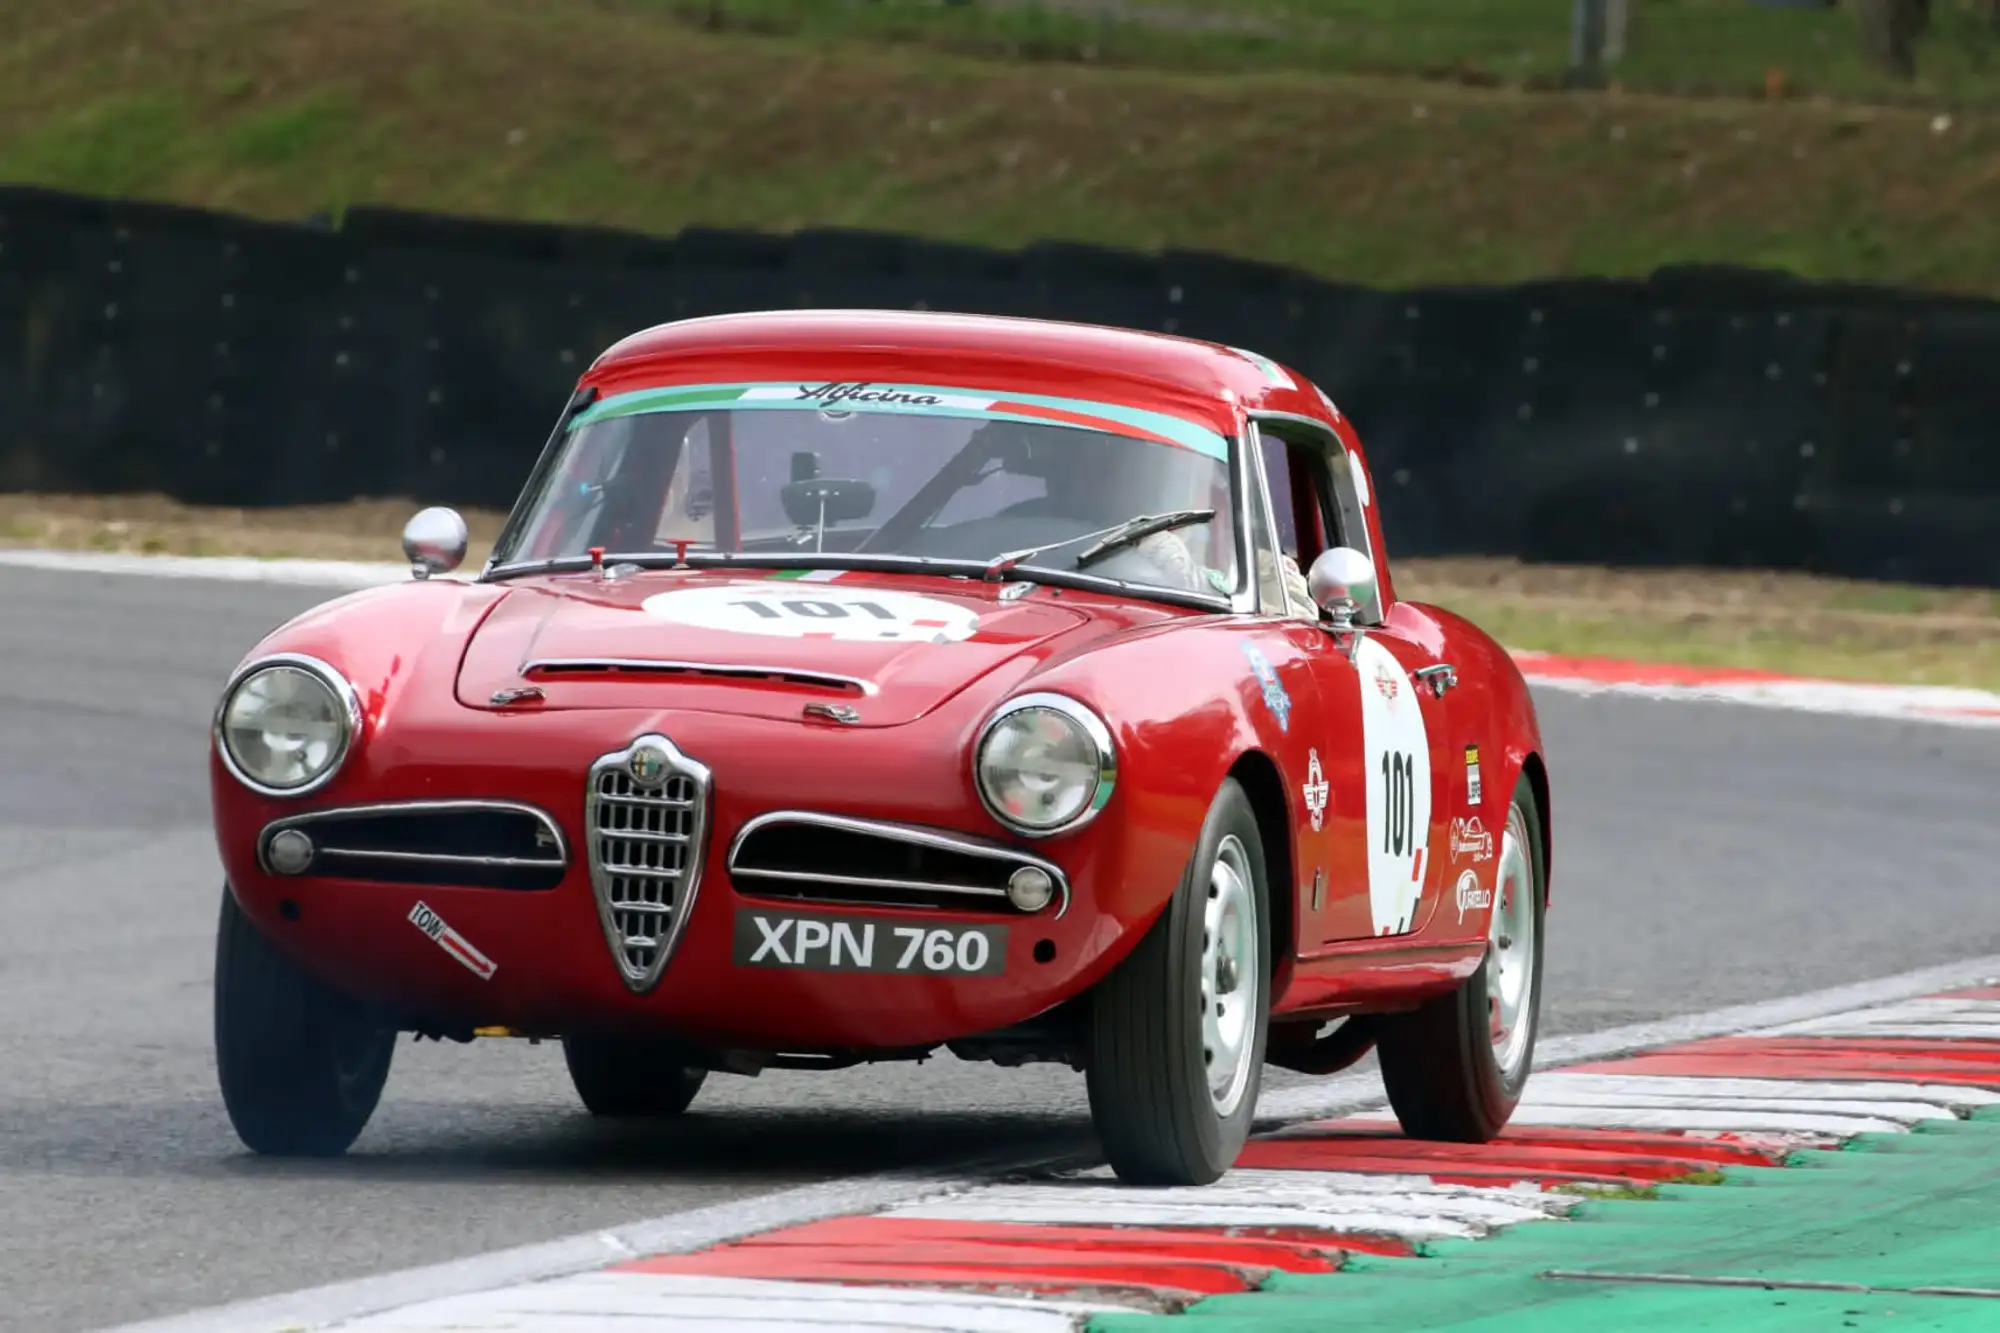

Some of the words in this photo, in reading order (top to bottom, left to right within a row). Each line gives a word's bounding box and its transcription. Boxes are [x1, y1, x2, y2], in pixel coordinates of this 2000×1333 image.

[727, 600, 897, 620] 101
[1381, 750, 1414, 857] 101
[412, 903, 446, 938] TOW
[750, 917, 875, 967] XPN
[893, 927, 989, 971] 760
